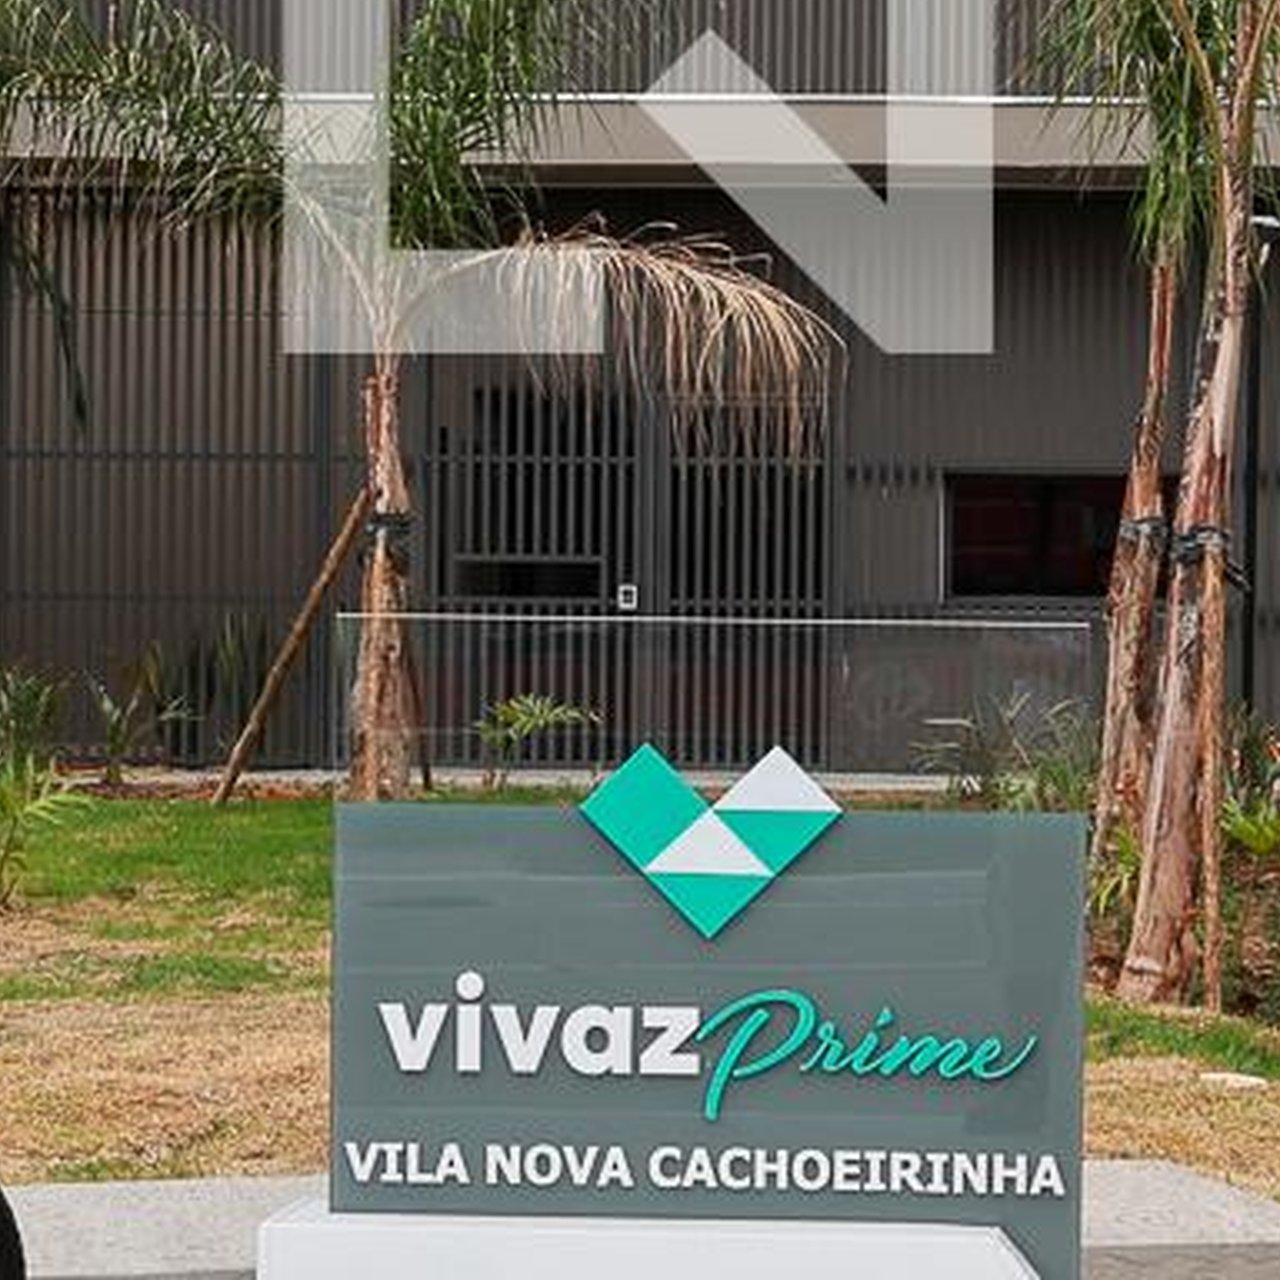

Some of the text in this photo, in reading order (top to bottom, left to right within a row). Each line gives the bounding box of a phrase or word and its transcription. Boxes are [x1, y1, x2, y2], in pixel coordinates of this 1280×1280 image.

[378, 970, 1038, 1120] vivaz Prime
[345, 1142, 1066, 1197] VILA NOVA CACHOEIRINHA
